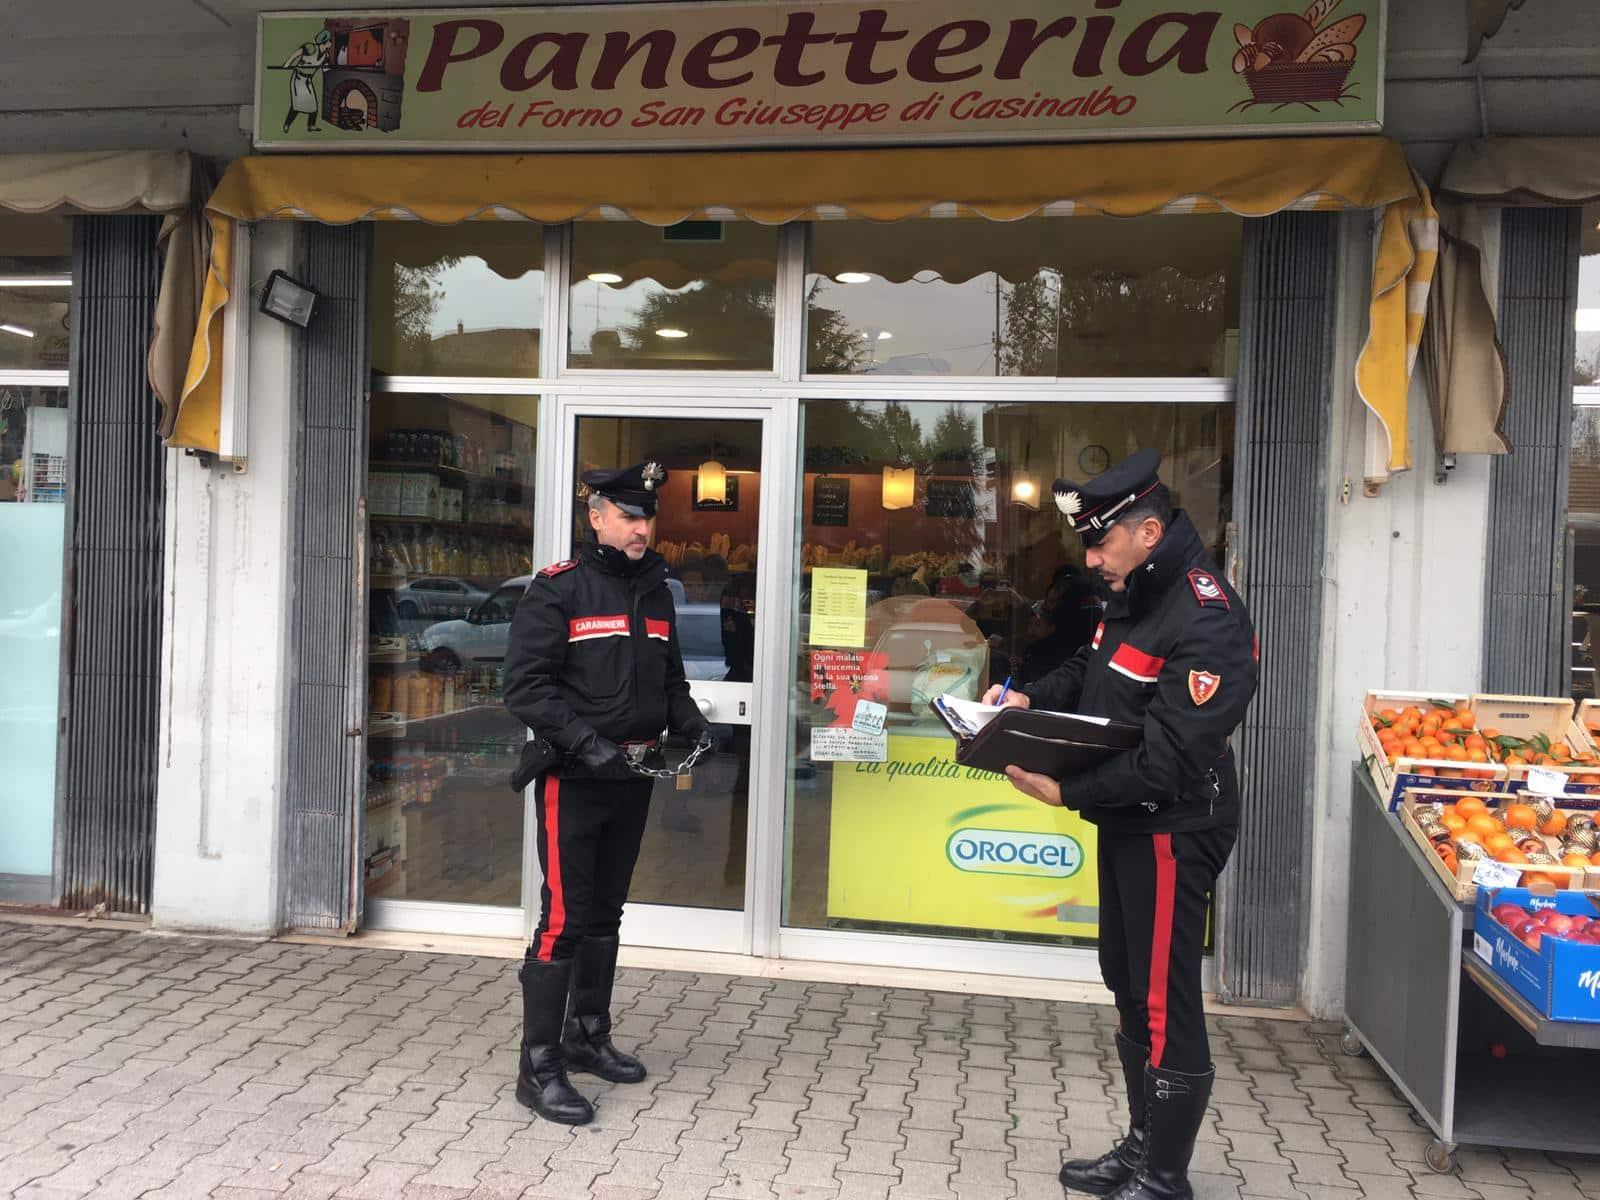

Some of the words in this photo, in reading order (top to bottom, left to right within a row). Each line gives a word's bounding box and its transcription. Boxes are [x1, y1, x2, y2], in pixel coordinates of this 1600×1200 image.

[416, 0, 1222, 93] Panetteria
[457, 101, 512, 128] del
[518, 100, 624, 128] Forno
[629, 100, 706, 127] San
[713, 97, 891, 131] Giuseppe
[899, 90, 943, 121] di
[950, 85, 1137, 121] Casinalbo
[813, 653, 834, 662] Ogni
